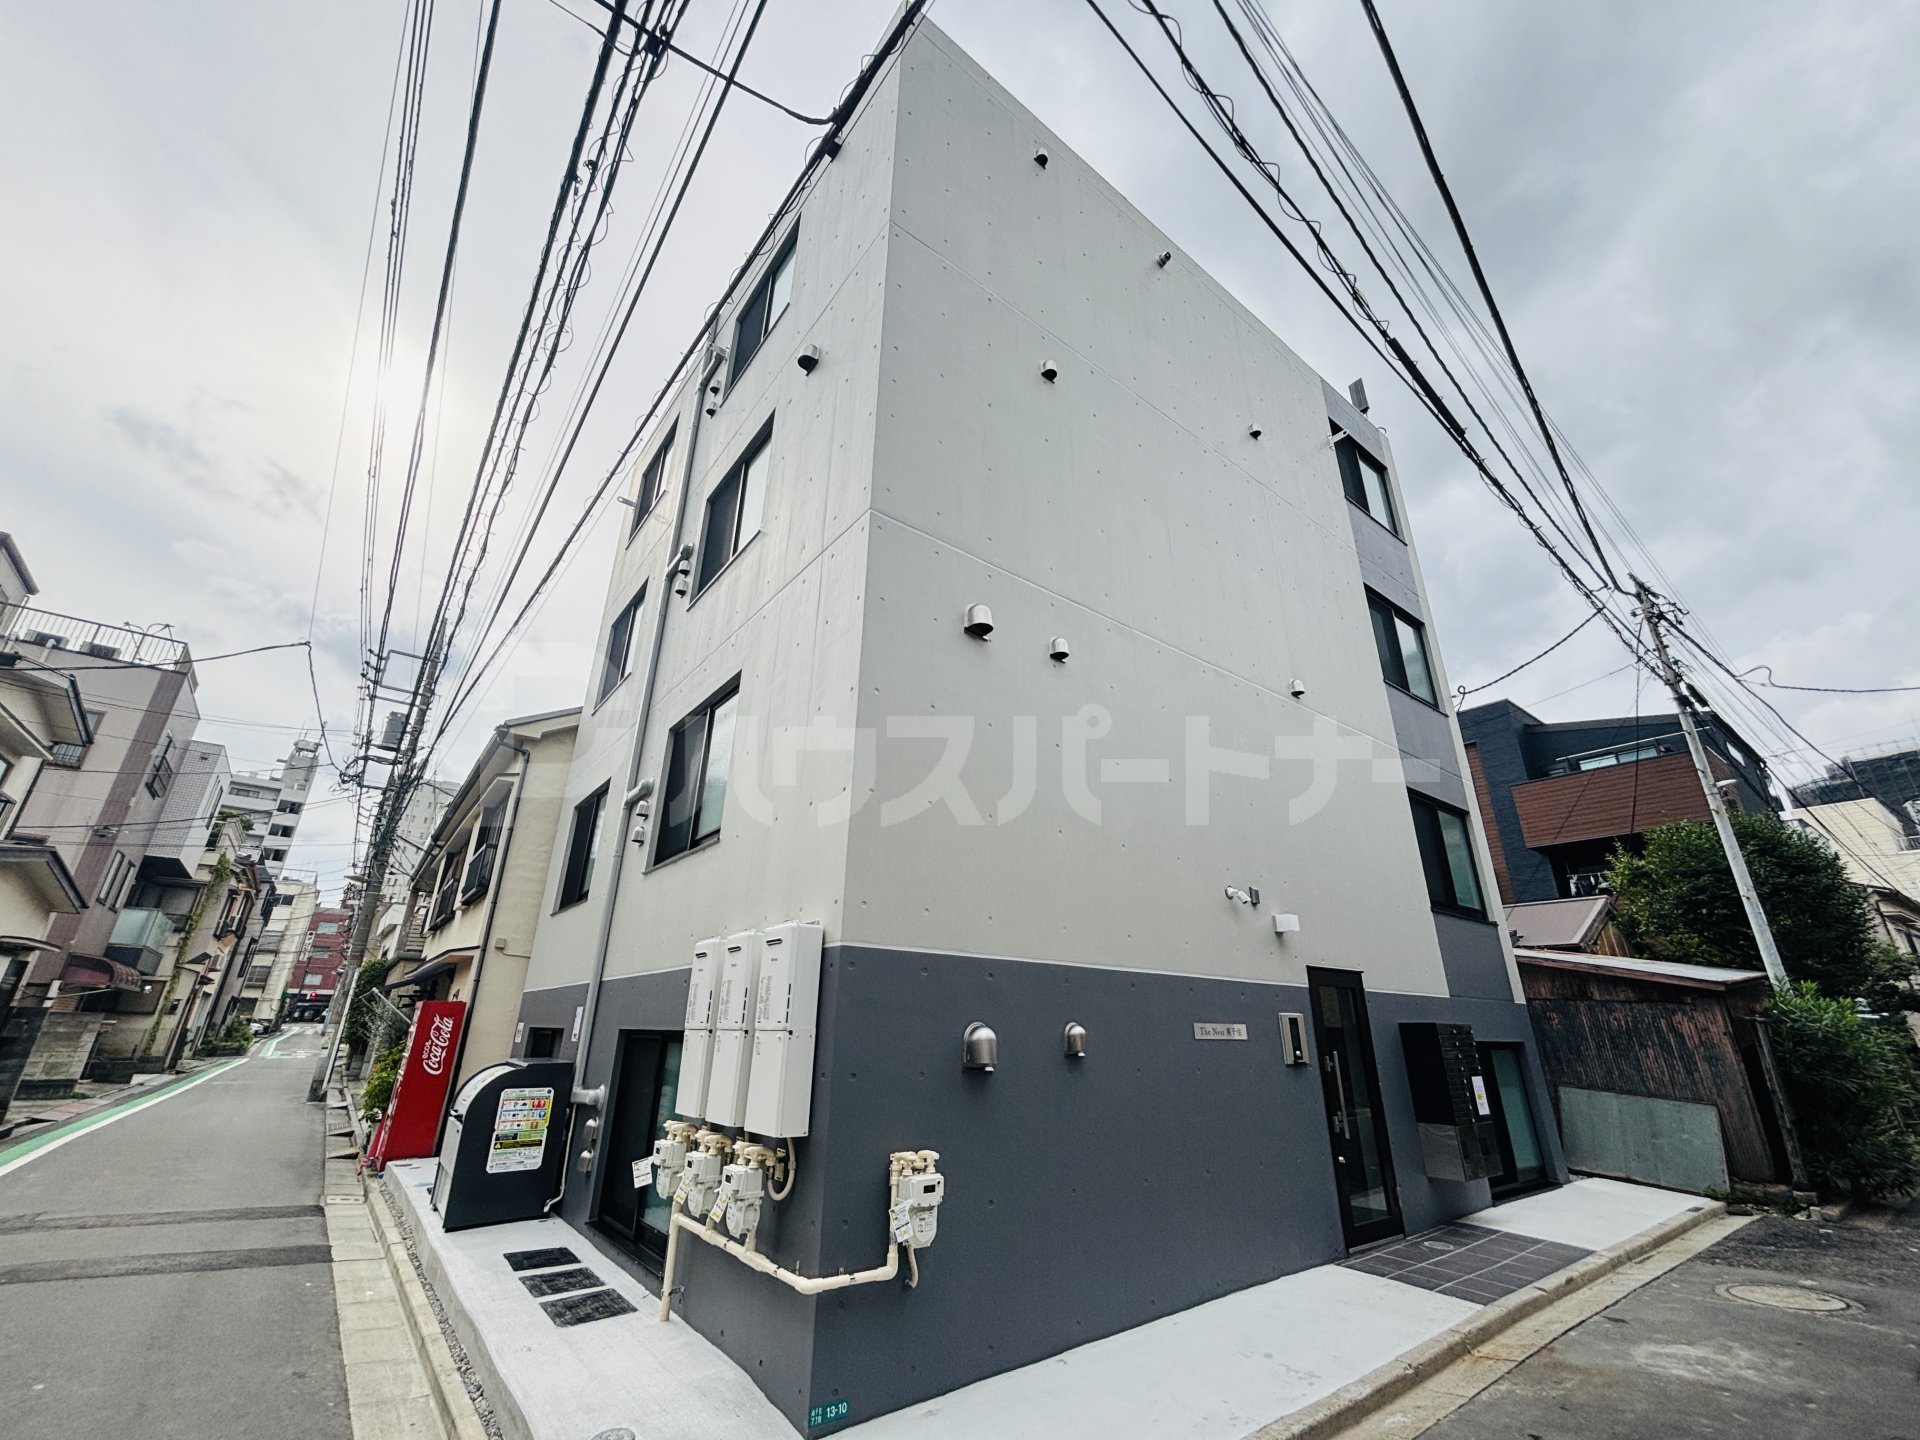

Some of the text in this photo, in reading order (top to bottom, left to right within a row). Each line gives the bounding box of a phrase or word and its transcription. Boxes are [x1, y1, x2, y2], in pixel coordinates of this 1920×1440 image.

[1200, 1026, 1211, 1036] The
[423, 1013, 454, 1075] Coca-Cola
[826, 1402, 848, 1418] 13-10
